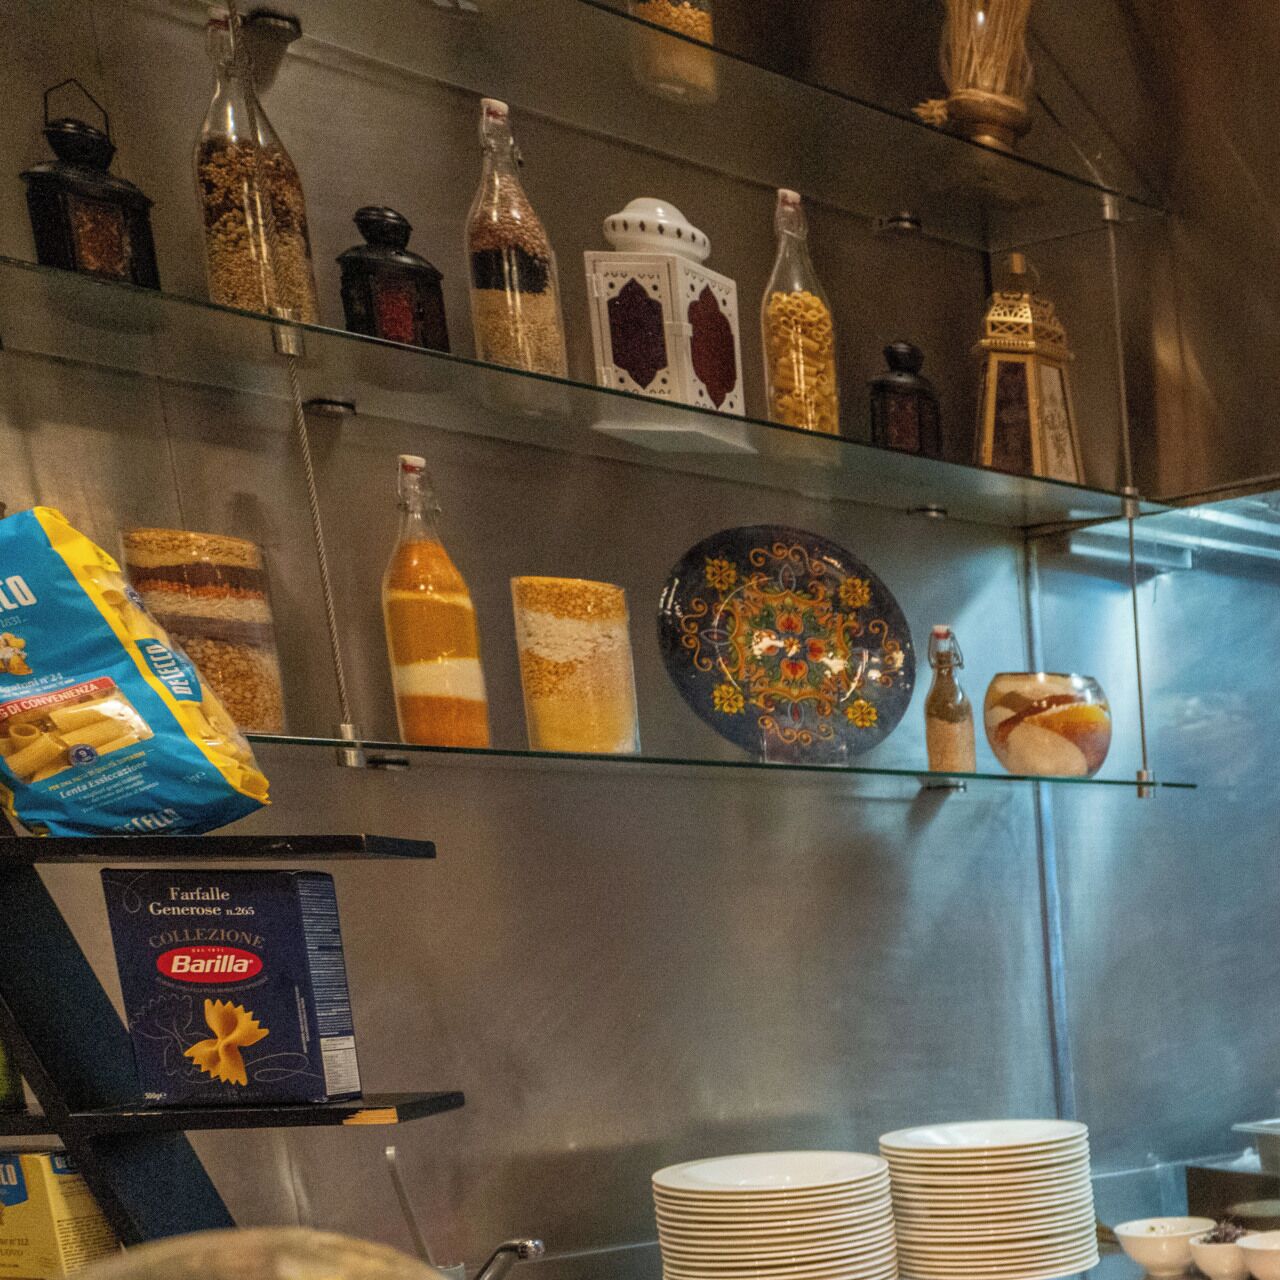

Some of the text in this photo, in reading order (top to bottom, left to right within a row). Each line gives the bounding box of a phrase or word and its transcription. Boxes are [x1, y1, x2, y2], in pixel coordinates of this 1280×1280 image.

[20, 683, 100, 710] CONVENIENZA
[59, 783, 88, 799] Lenta
[169, 887, 230, 900] Farfalle
[149, 902, 255, 916] Generose n.265
[149, 928, 265, 948] COLLEZIONE
[170, 954, 250, 973] Barilla
